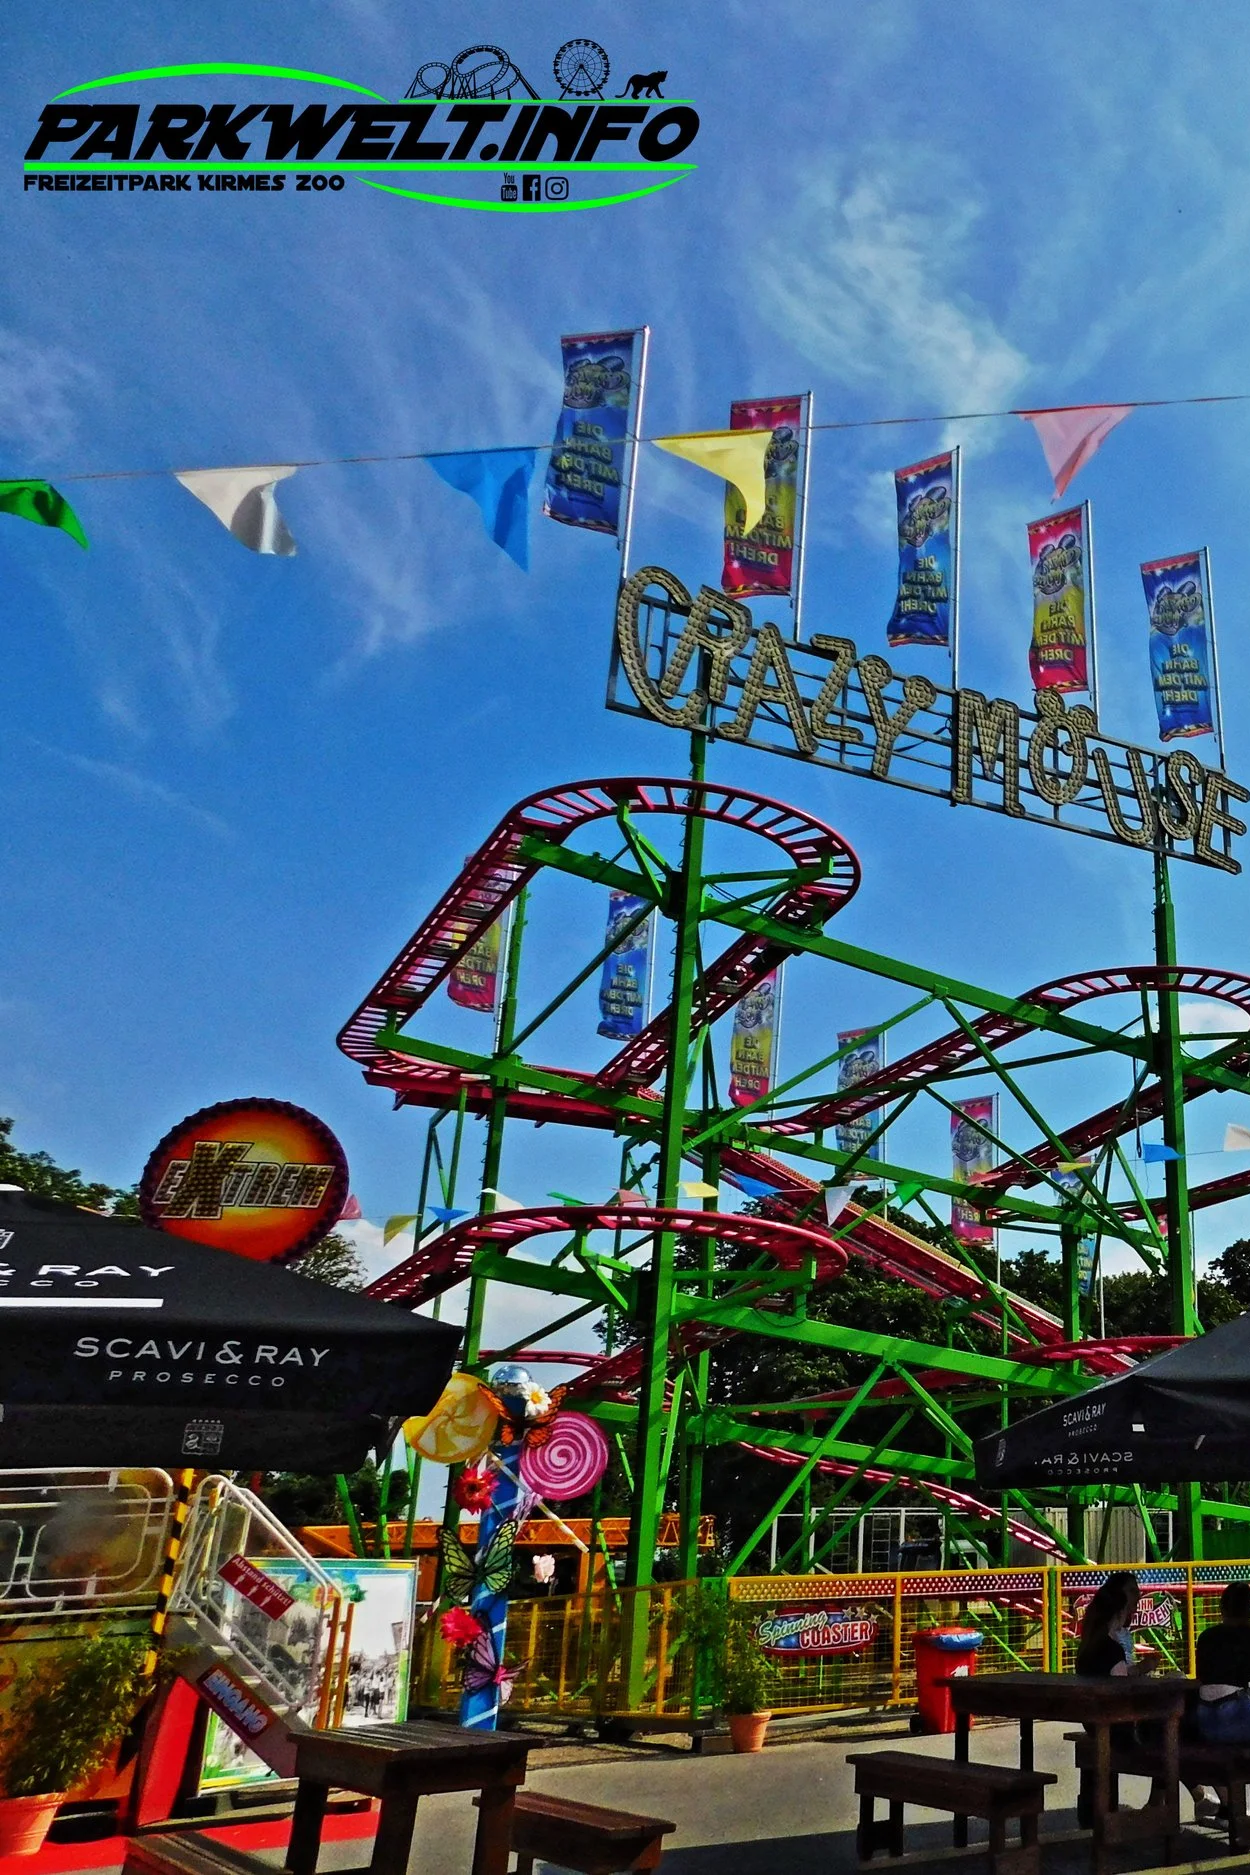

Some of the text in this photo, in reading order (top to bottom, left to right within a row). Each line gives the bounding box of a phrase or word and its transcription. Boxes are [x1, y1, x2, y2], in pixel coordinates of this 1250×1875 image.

[617, 565, 937, 780] CRAZY
[152, 1141, 336, 1220] EXTREM
[38, 1264, 176, 1277] RAY
[108, 1370, 285, 1388] PROSECCO
[231, 1556, 293, 1607] Abstand schützt!
[758, 1610, 828, 1647] Spinning
[799, 1620, 871, 1649] COASTER
[203, 1669, 269, 1733] EINGANG
